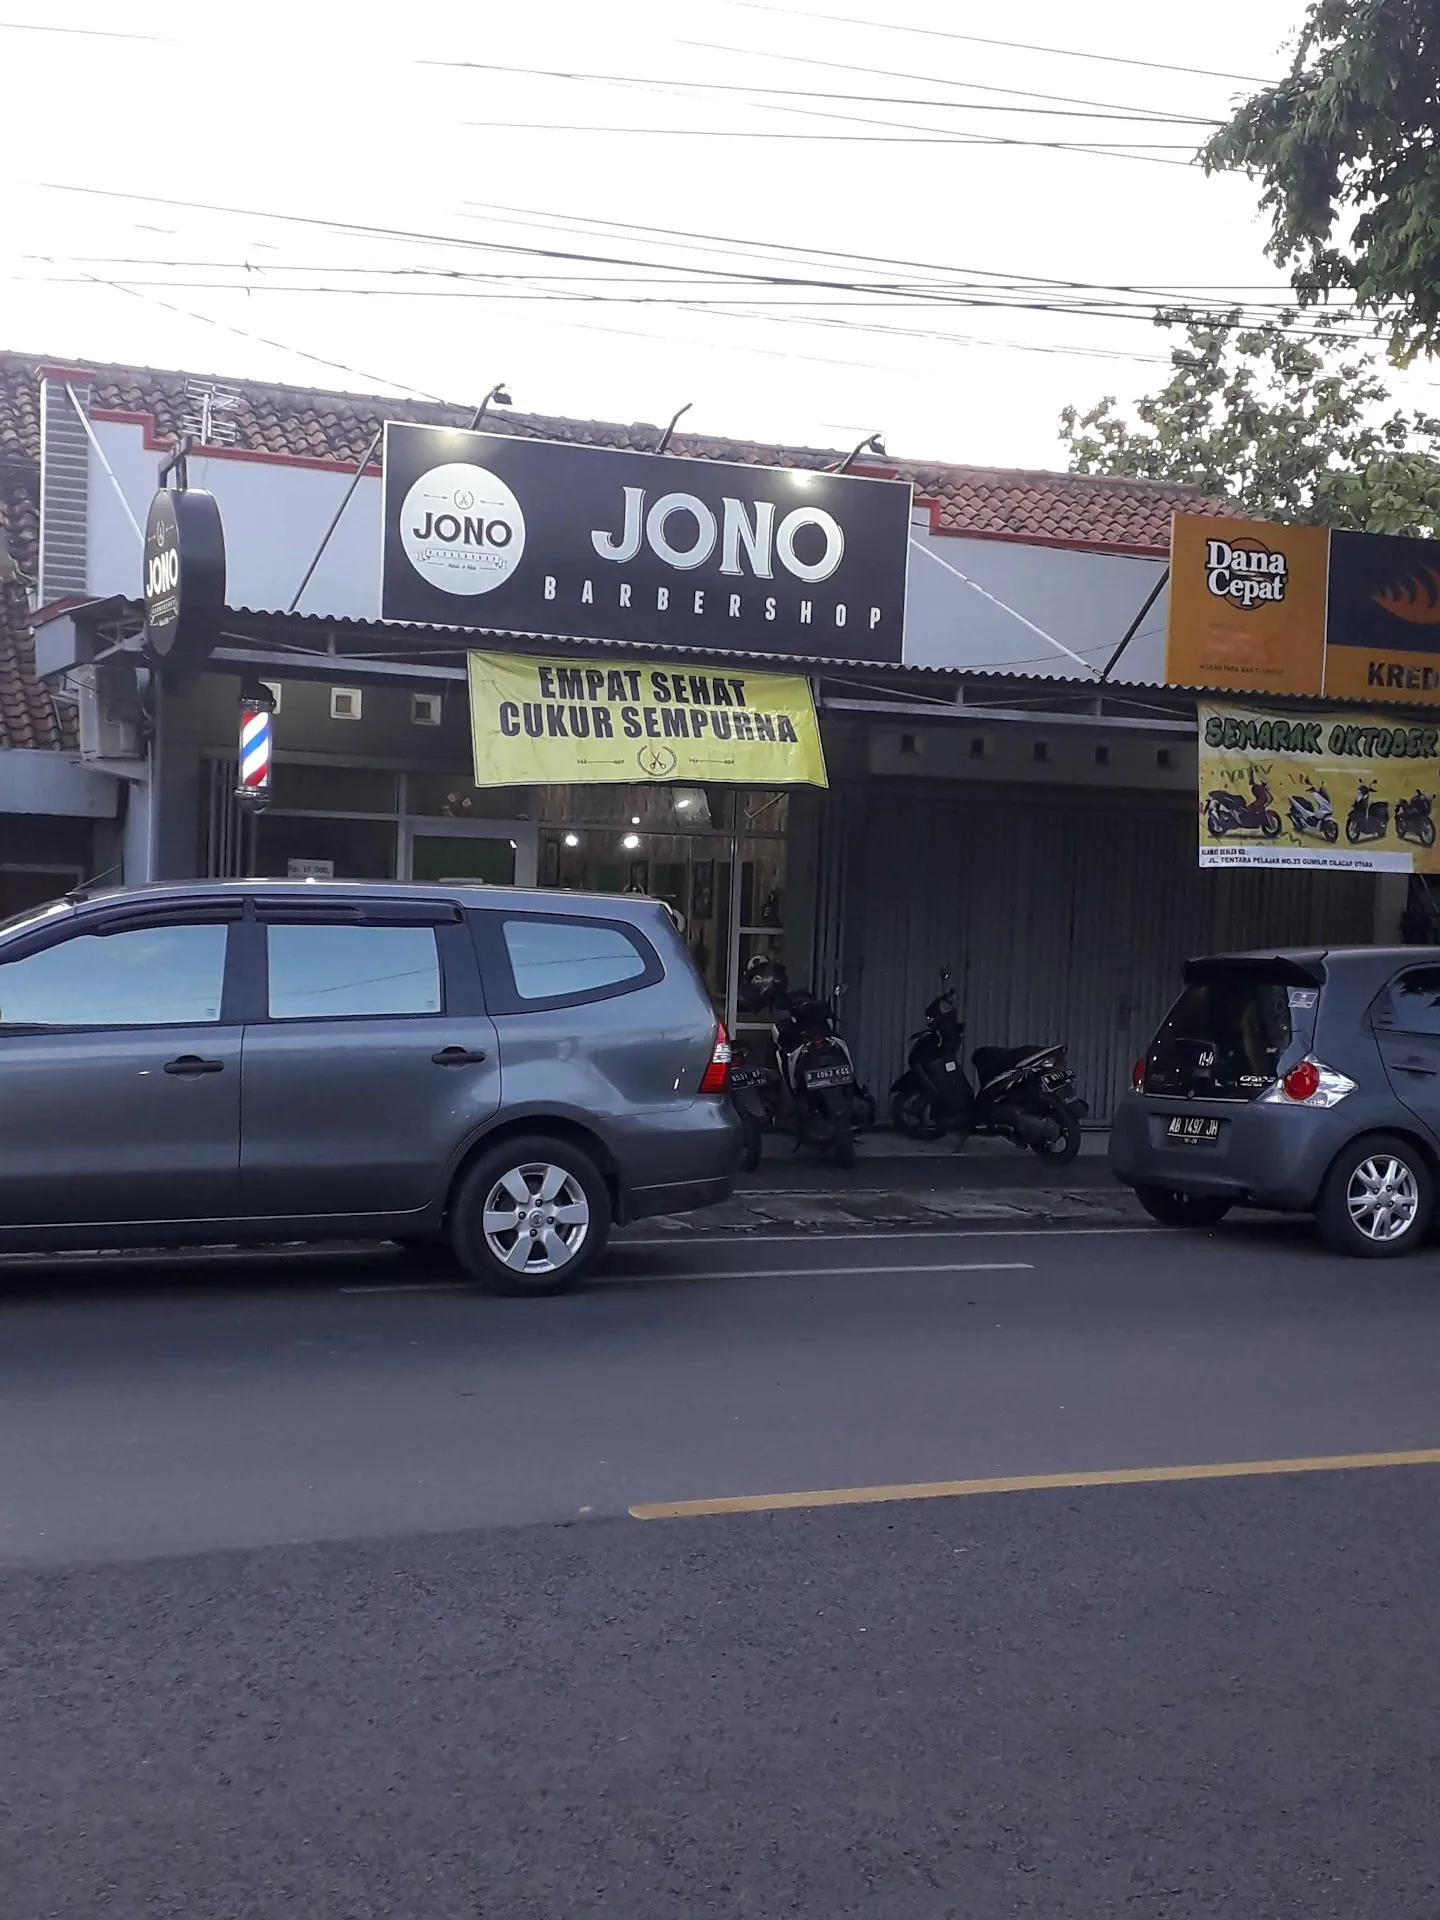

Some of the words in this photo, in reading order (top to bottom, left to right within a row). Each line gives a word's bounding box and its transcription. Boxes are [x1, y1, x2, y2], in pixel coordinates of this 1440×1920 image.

[412, 511, 513, 548] JONO
[591, 486, 845, 583] JONO
[146, 547, 179, 598] JONO
[1206, 540, 1286, 575] Dana
[544, 575, 882, 630] BARBERSHOP
[1208, 568, 1284, 605] Cepat
[537, 666, 642, 702] EMPAT
[650, 671, 747, 707] SEHAT
[499, 701, 615, 739] CUKUR
[622, 706, 799, 743] SEMPURNA
[1205, 717, 1323, 755] SEMARAK
[1328, 724, 1439, 759] OKTOBER
[1169, 1117, 1181, 1133] AB
[1183, 1118, 1204, 1134] 1497
[1206, 1119, 1218, 1136] JH
